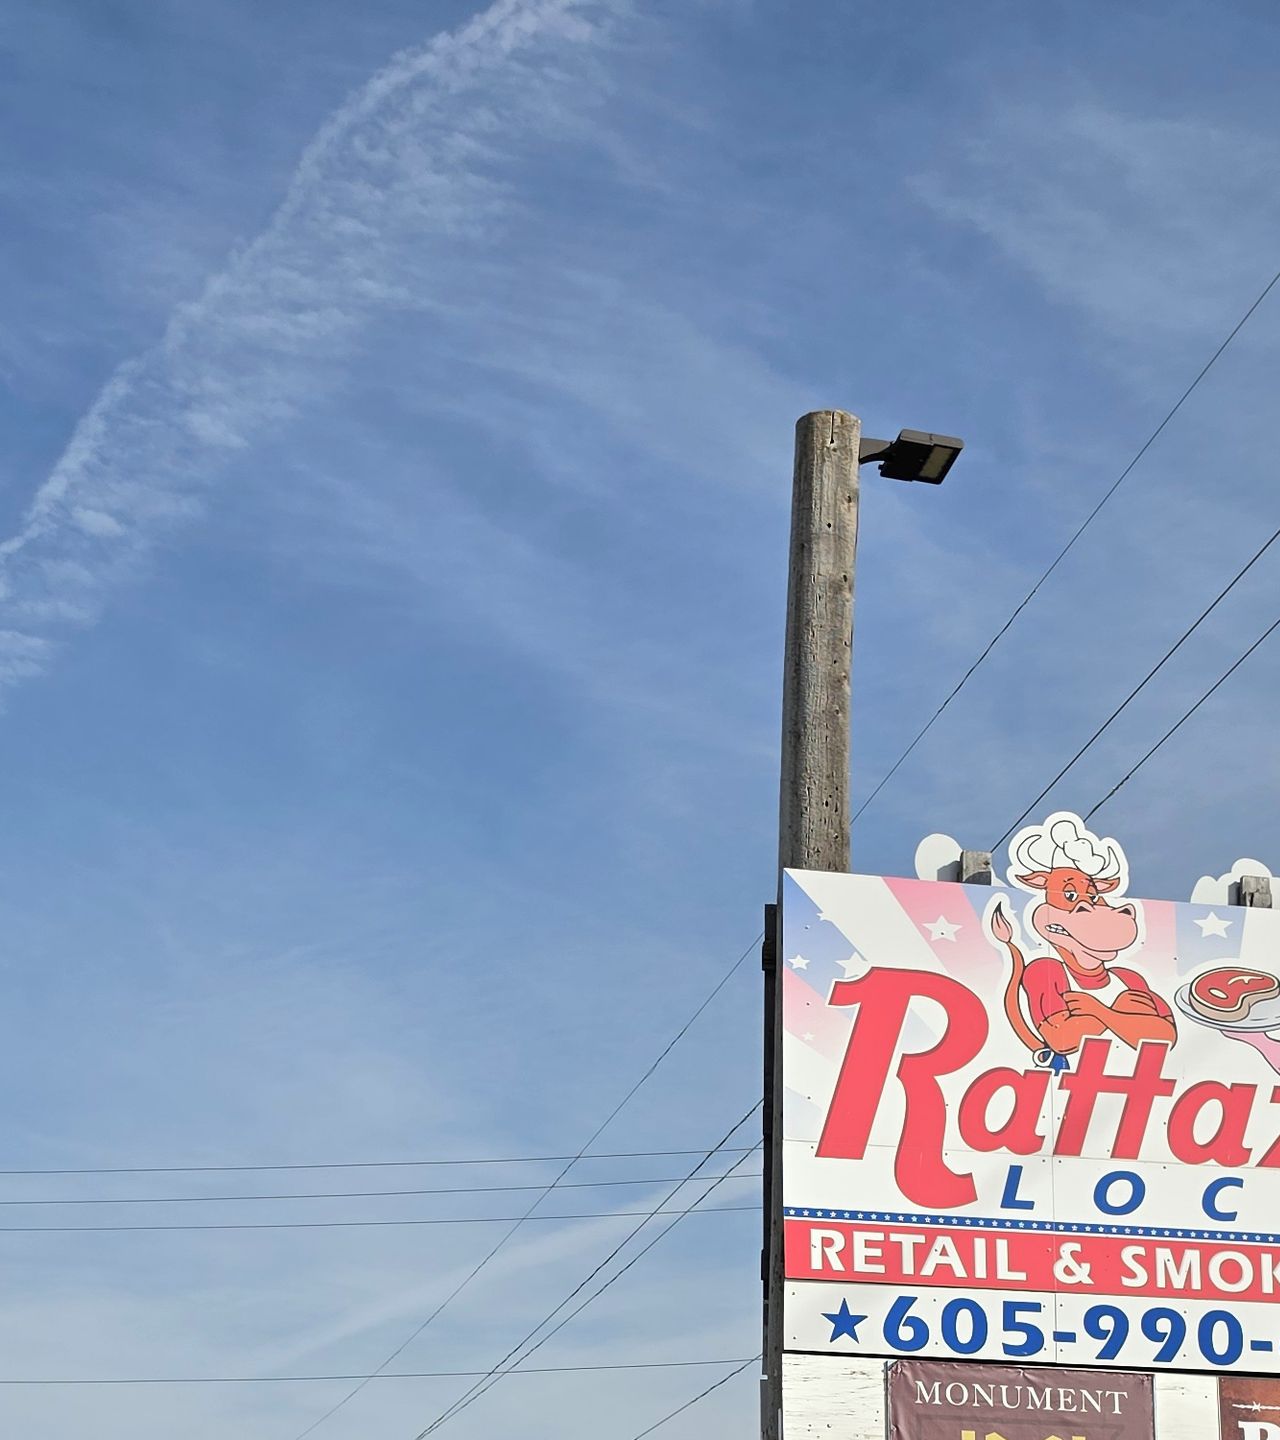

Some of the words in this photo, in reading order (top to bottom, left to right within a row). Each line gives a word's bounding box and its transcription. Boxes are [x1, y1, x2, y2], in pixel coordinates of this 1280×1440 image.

[809, 1228, 1027, 1282] RETAIL
[1052, 1241, 1095, 1285] &
[914, 1380, 1129, 1415] MONUMENT
